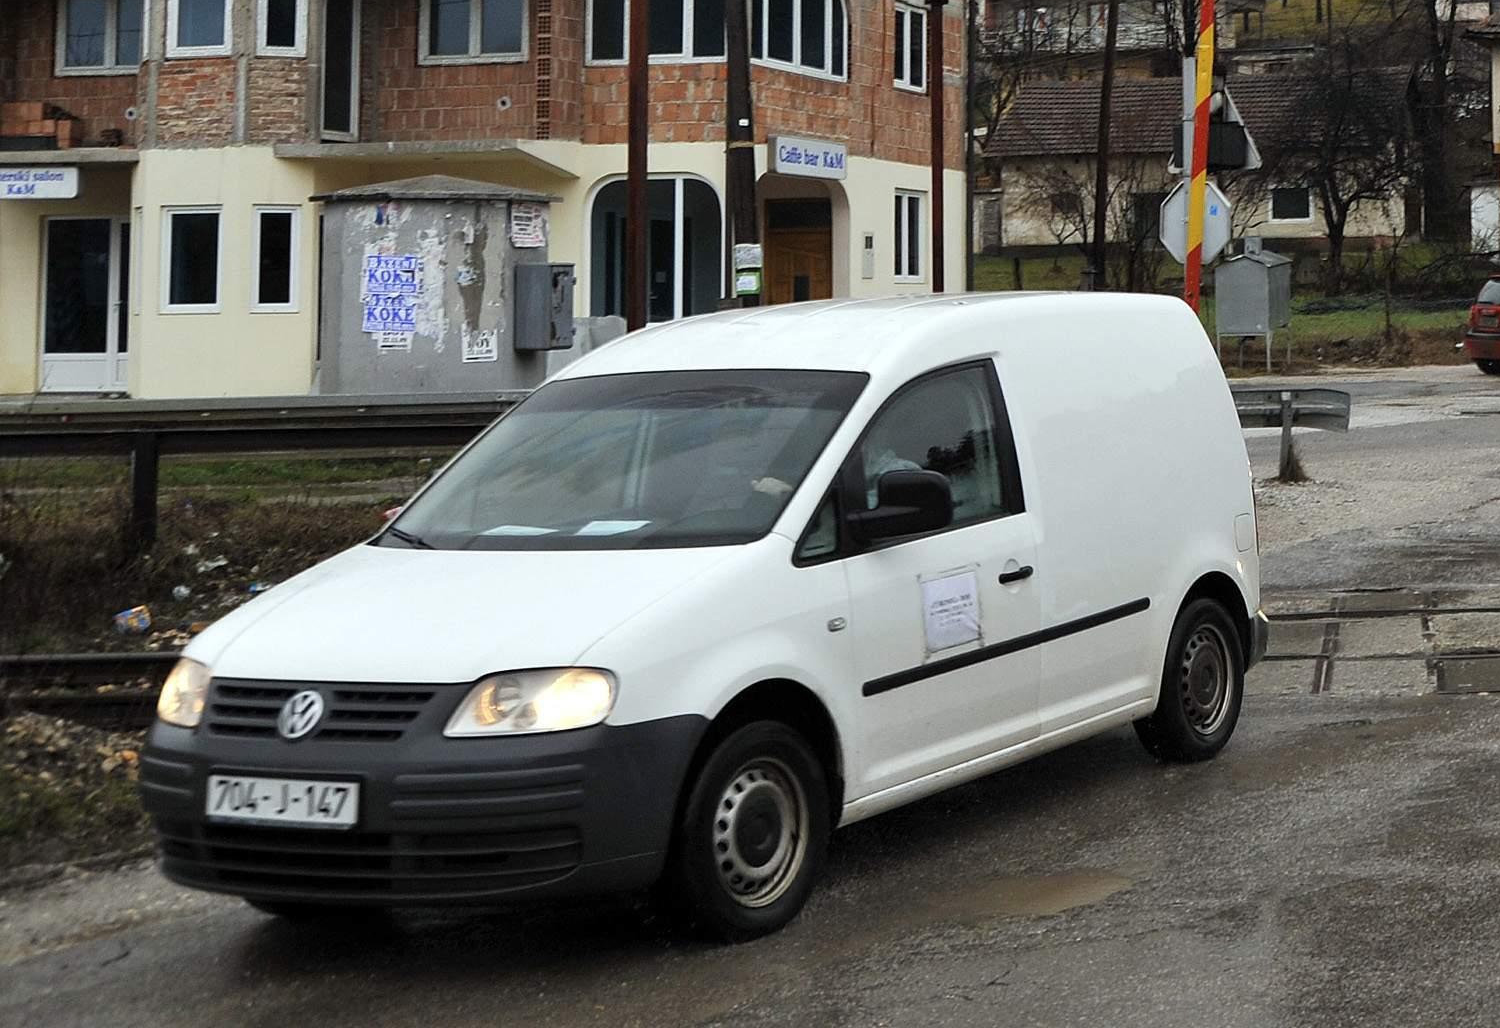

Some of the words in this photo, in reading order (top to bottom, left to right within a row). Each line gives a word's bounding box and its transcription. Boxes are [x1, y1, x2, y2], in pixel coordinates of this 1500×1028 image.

[779, 145, 802, 164] Caffe
[804, 149, 819, 166] bar
[367, 307, 415, 322] KOKE
[214, 779, 350, 819] 704-J-147
